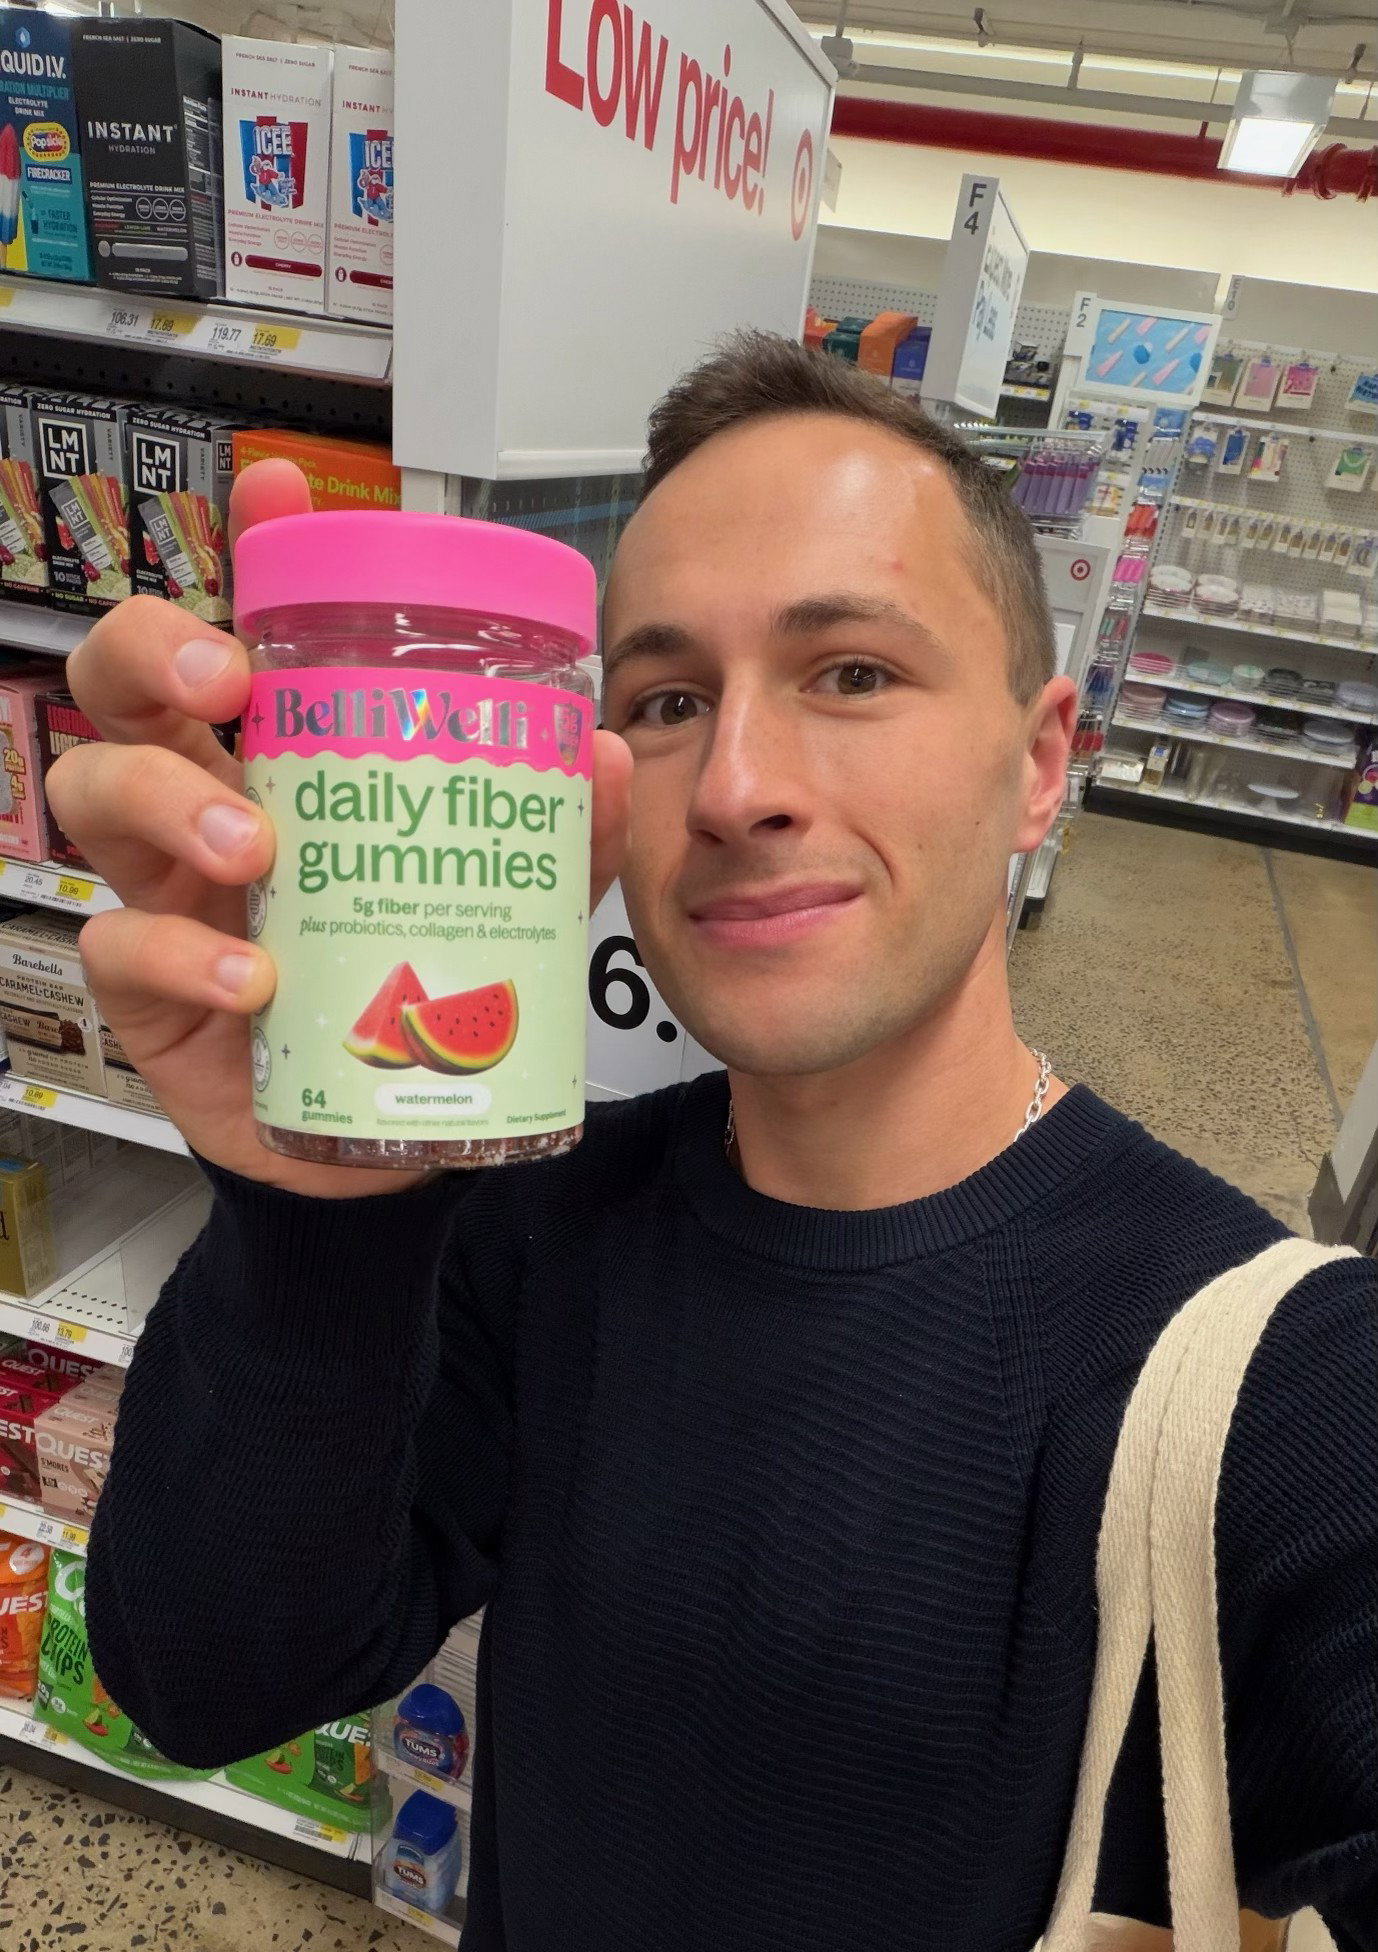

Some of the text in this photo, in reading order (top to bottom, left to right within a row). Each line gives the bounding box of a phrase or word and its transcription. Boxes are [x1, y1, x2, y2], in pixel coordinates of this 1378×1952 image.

[0, 50, 66, 79] QUID I.V.
[0, 81, 26, 94] RATION
[8, 97, 48, 108] ELECTROLYTE
[231, 88, 321, 106] INSTANT HYDRATION
[15, 107, 32, 116] DRINK
[342, 101, 380, 113] INSTANT
[545, 0, 774, 216] Low price!
[87, 121, 173, 142] INSTANT
[255, 126, 292, 155] ICEE
[108, 145, 156, 154] HYDRATION
[27, 167, 71, 181] FIRECRACKER
[116, 183, 153, 192] ELECTROLYTE
[228, 209, 254, 218] PREMIUM
[255, 213, 293, 224] ELECTROLYTE
[294, 218, 312, 226] DRINK
[111, 311, 139, 327] 106.31
[212, 326, 242, 342] 119.77
[37, 403, 111, 419] ZERO SUGAR HYDRATION
[132, 417, 205, 438] ZERO SUGAR HYDRATION
[48, 428, 79, 451] LM
[50, 450, 79, 473] NT
[141, 442, 171, 468] LM
[142, 464, 171, 489] NT
[327, 477, 370, 500] Drink
[54, 572, 65, 582] 10
[275, 687, 527, 749] BelliWelli
[295, 770, 565, 837] daily fiber
[298, 838, 557, 894] gummies
[58, 884, 79, 895] 10.99
[353, 897, 512, 923] 5g fiber per serving
[299, 916, 557, 944] plus probiotics, collagen & electrolytes
[12, 954, 63, 976] Barebells
[301, 1088, 326, 1108] 64
[395, 1093, 473, 1105] watermelon
[301, 1110, 353, 1124] gummies
[506, 1109, 567, 1125] Dietary Supplement
[2, 1358, 46, 1376] QUEST
[28, 1348, 96, 1376] QUES
[53, 1407, 99, 1424] QUEST
[41, 1457, 69, 1473] S'MORES
[405, 1738, 437, 1757] TUMS
[398, 1865, 423, 1884] TUMS
